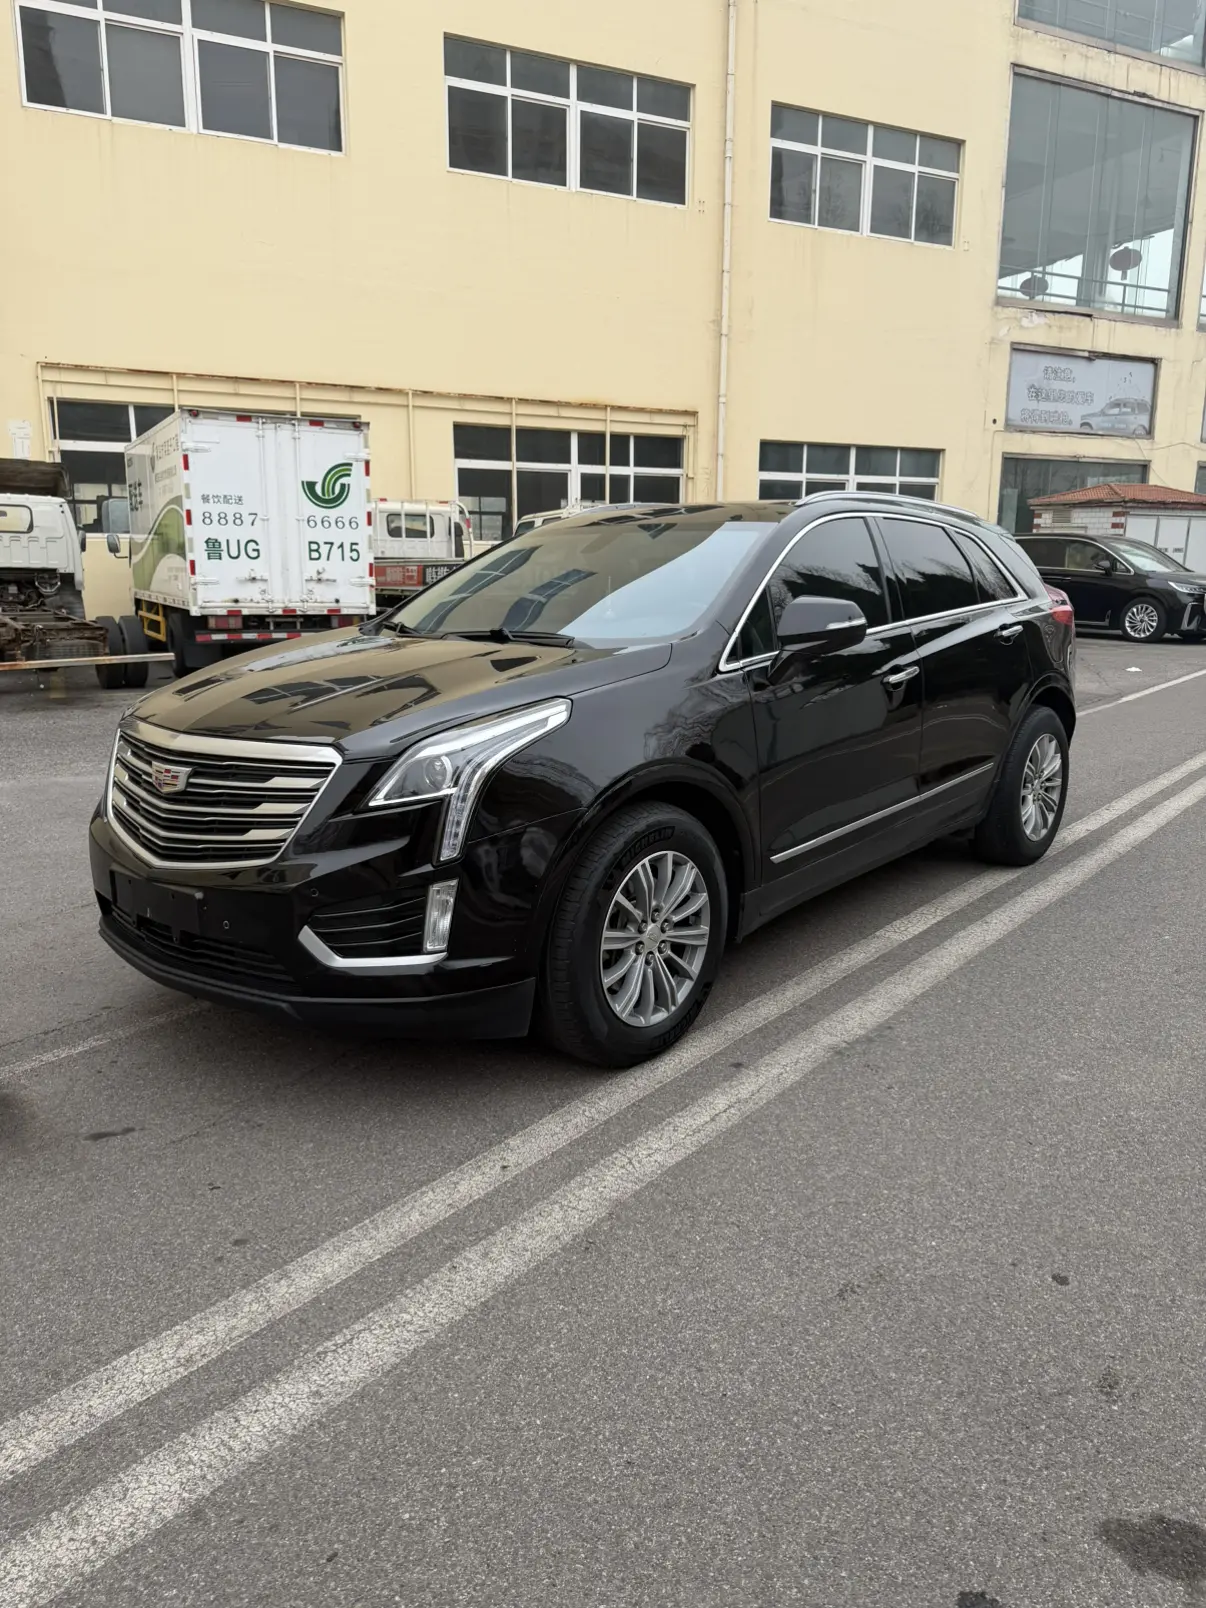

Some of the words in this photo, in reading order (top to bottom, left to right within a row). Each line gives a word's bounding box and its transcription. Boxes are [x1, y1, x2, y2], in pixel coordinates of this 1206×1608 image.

[201, 493, 244, 505] 餐饮配送
[202, 512, 258, 526] 8887
[307, 515, 359, 530] 6666
[204, 537, 260, 560] 鲁UG
[308, 541, 360, 562] B715
[620, 825, 676, 866] MICHELIN
